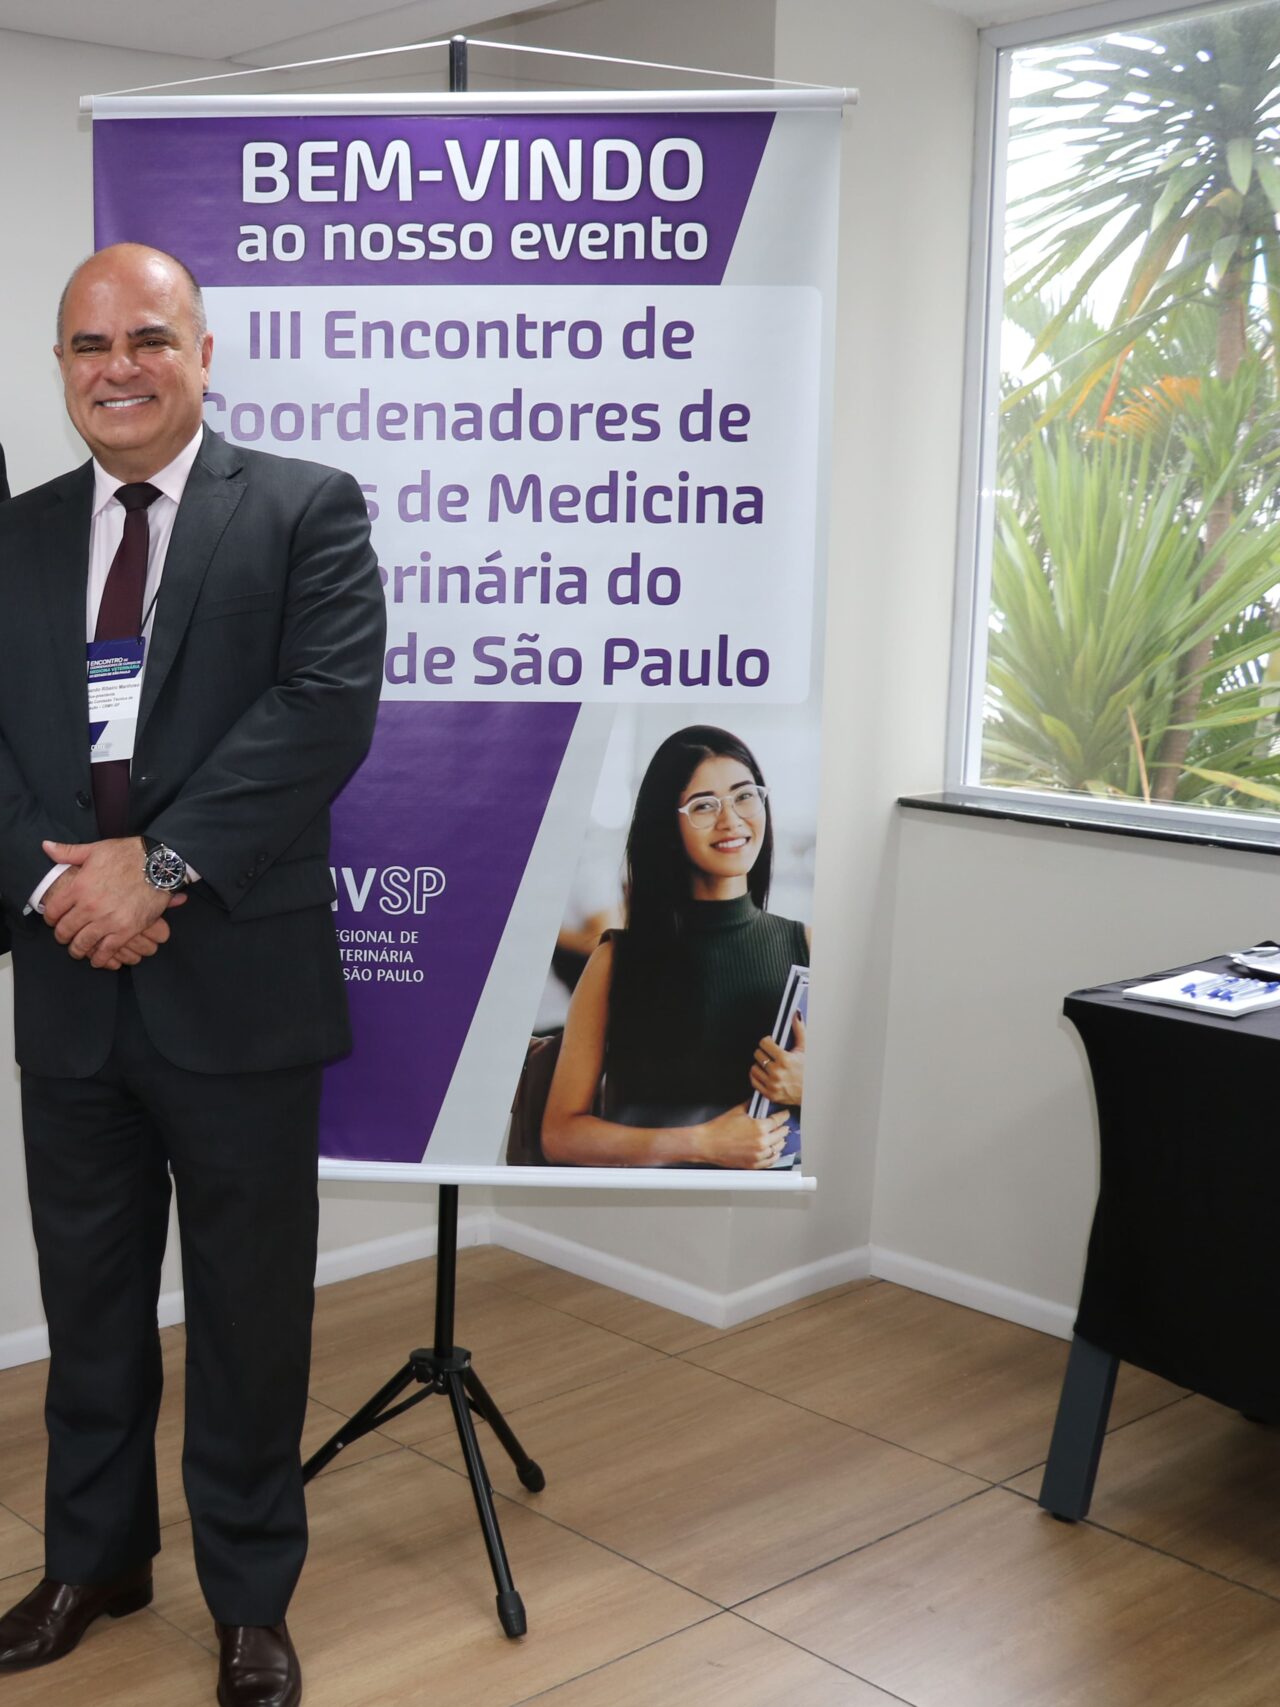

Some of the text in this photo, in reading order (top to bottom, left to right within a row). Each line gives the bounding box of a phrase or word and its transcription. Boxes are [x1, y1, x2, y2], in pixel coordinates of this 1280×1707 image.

[241, 137, 704, 204] BEM-VINDO
[237, 216, 708, 263] ao nosso evento
[250, 305, 695, 360] III Encontro de
[680, 388, 751, 443] de
[398, 470, 470, 523] de
[489, 469, 764, 525] Medicina
[379, 549, 682, 606] rinária do
[384, 632, 770, 687] de São Paulo
[400, 930, 419, 944] DE
[342, 965, 424, 983] SÃO PAULO
